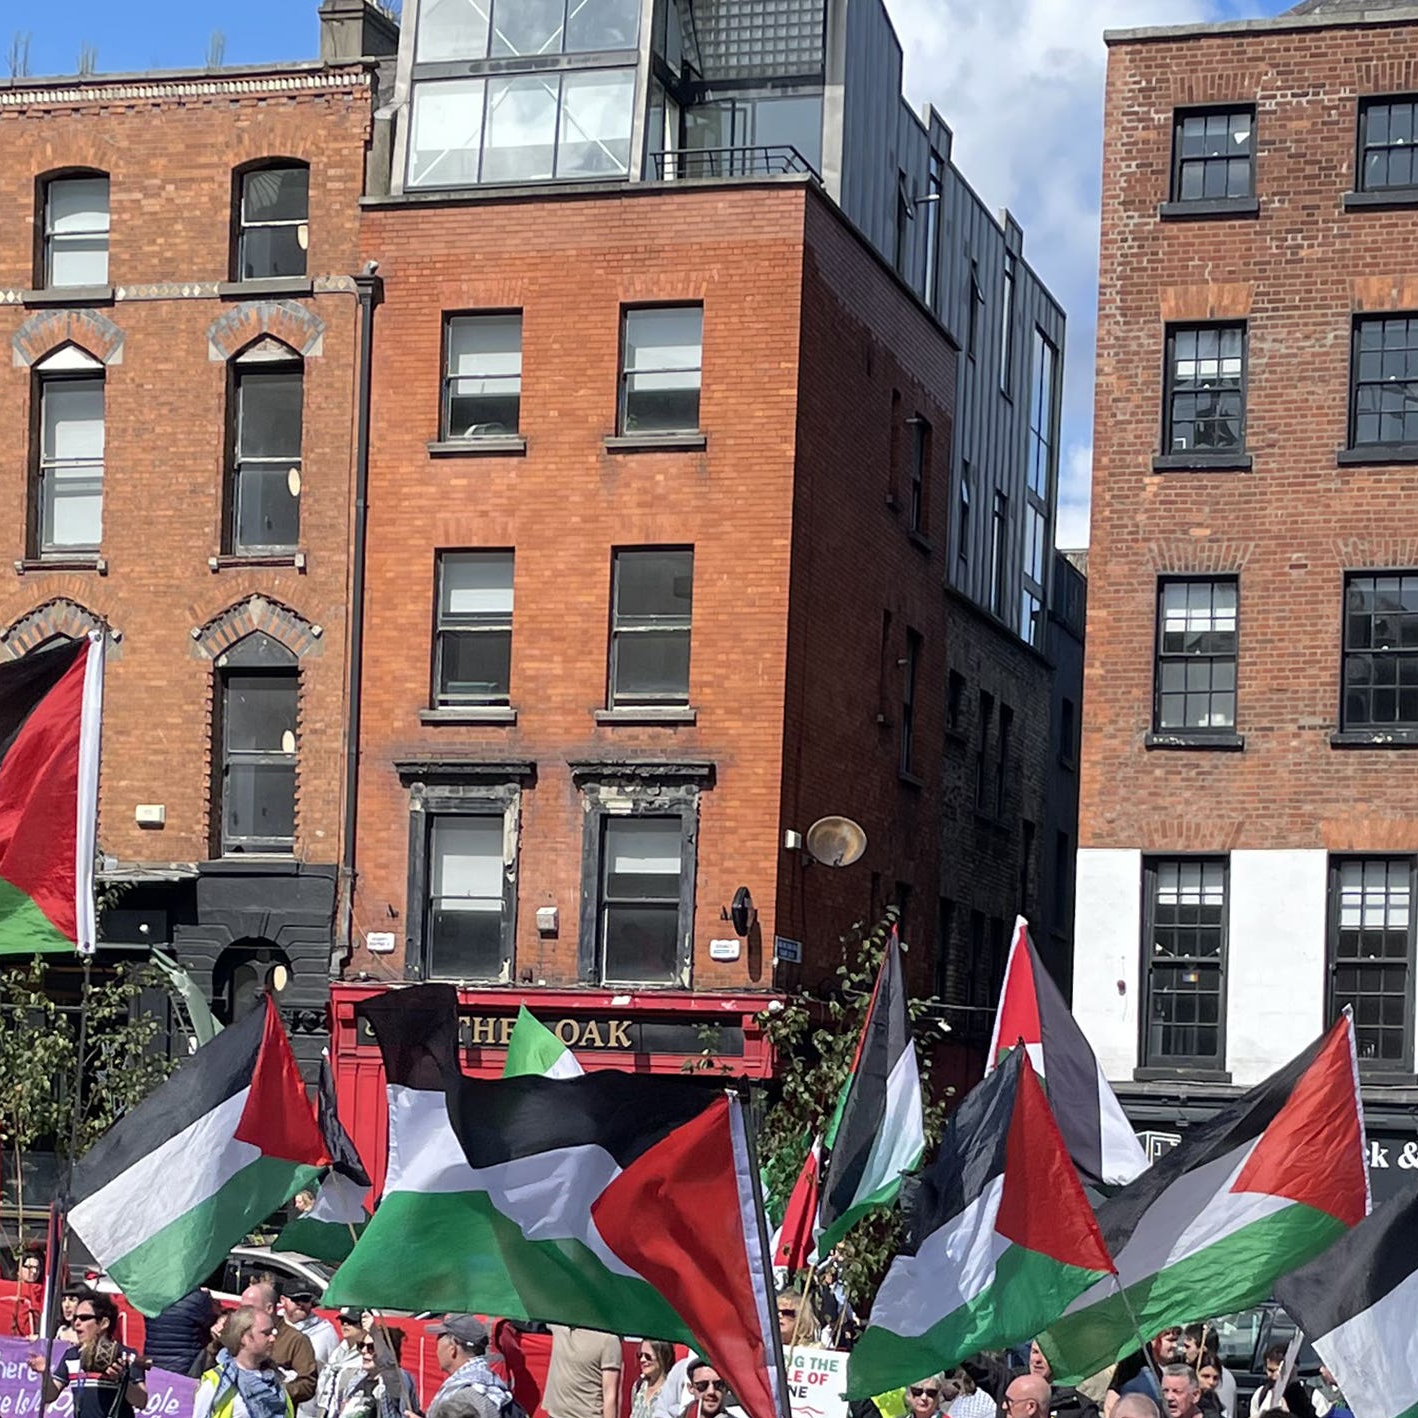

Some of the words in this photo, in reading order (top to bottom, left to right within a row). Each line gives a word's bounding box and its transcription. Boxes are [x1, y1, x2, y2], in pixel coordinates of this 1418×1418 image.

[554, 1019, 633, 1048] OAK
[809, 1357, 839, 1373] THE
[807, 1372, 829, 1386] OF
